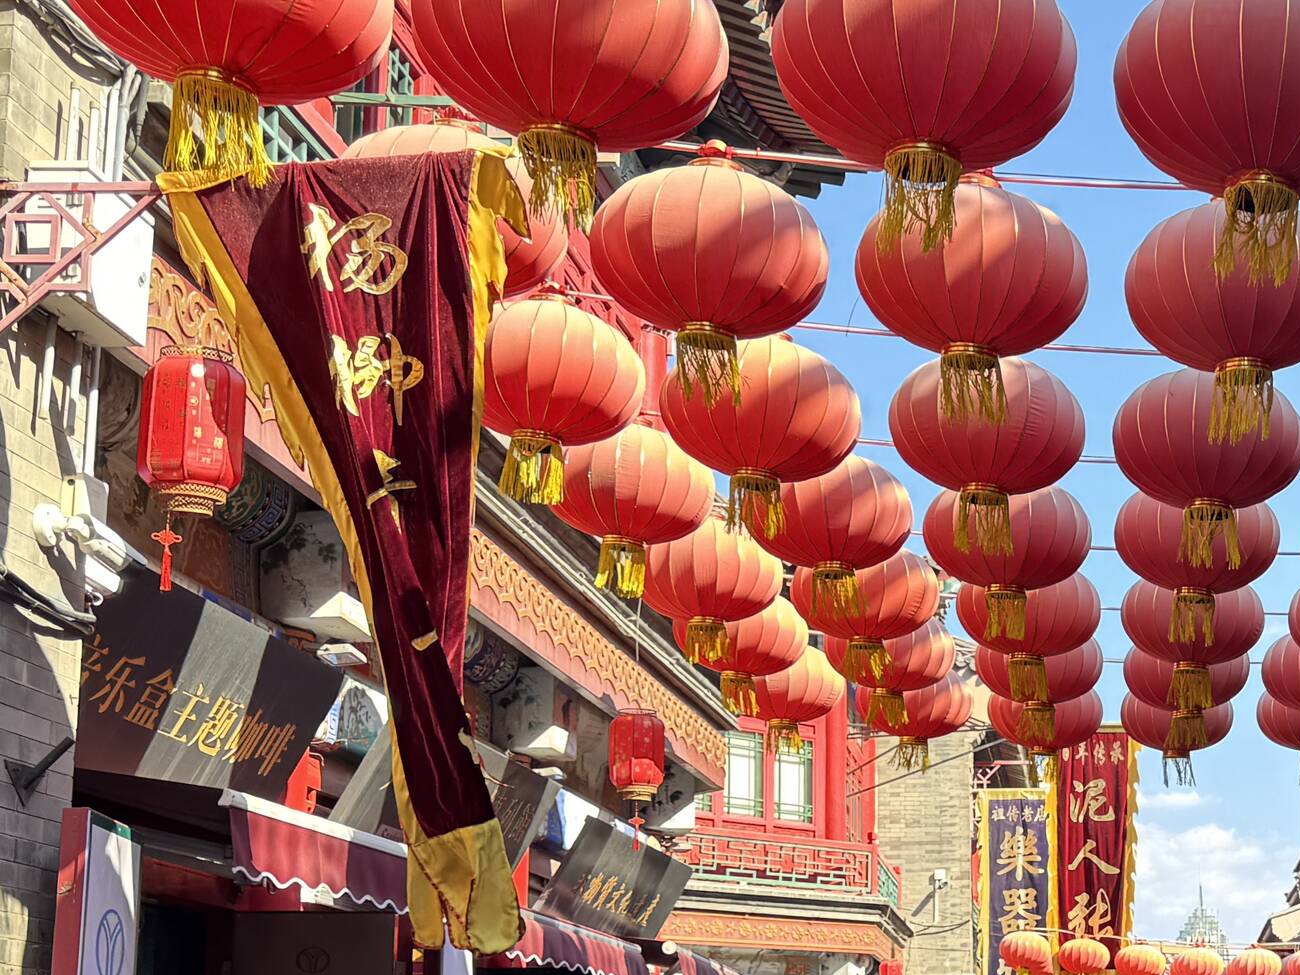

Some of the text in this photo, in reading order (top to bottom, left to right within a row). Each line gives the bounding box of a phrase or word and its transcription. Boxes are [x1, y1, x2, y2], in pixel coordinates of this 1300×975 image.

[82, 634, 296, 776] 音乐盒主题咖啡
